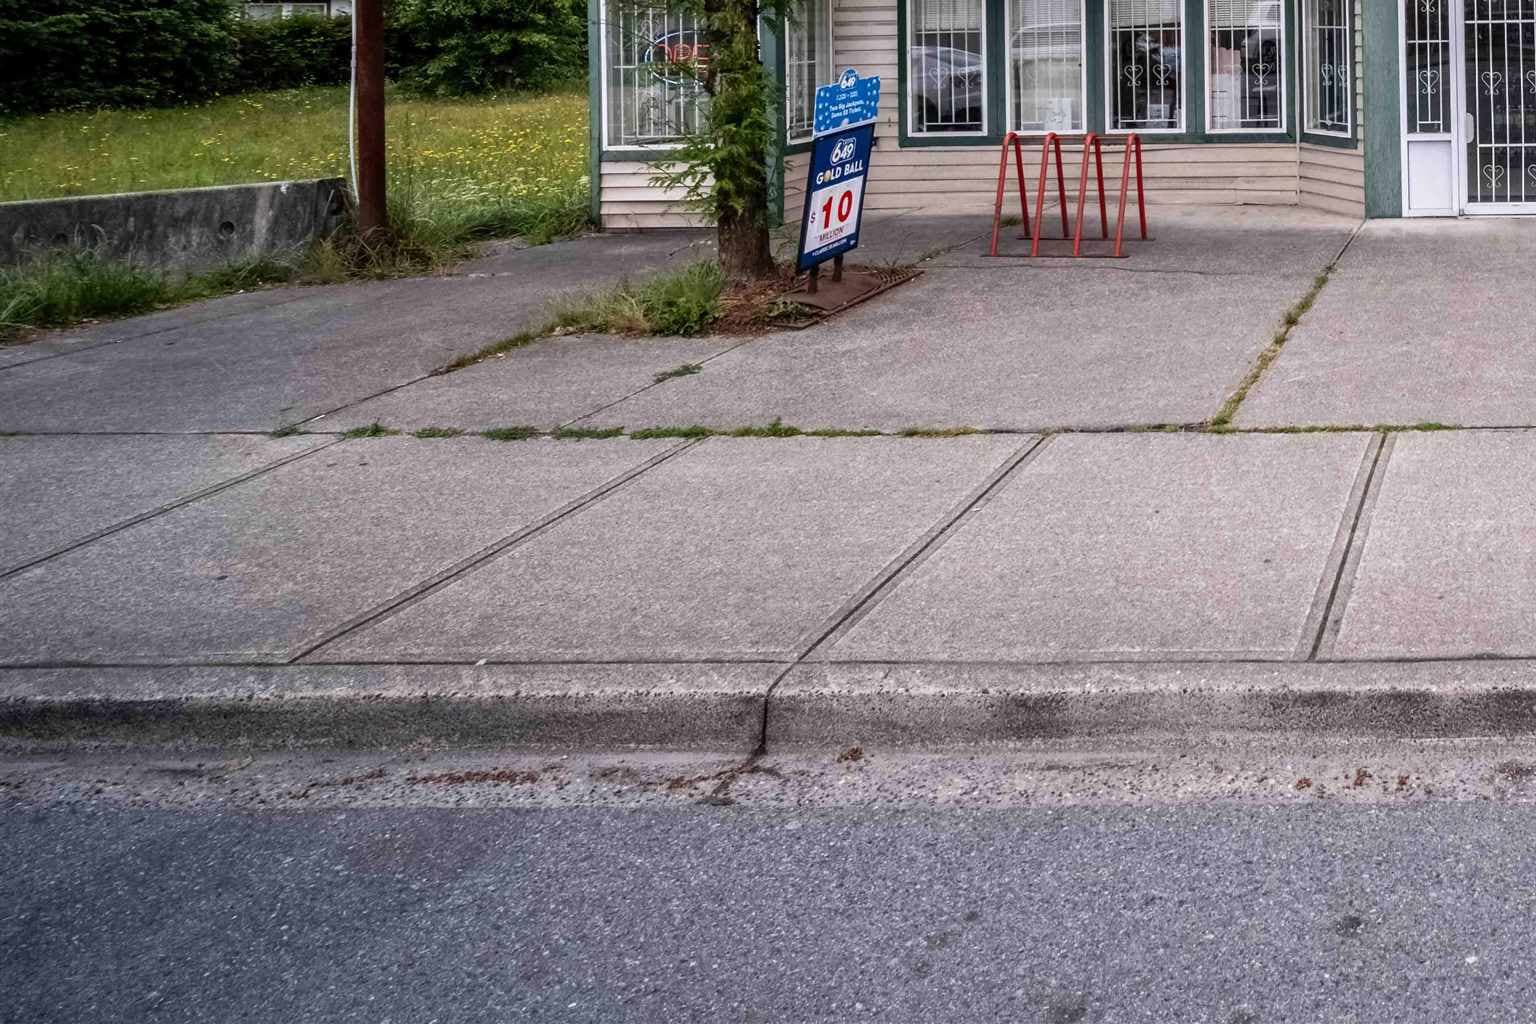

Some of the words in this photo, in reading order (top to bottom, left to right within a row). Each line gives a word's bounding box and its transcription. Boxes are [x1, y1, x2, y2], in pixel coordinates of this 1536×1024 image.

[841, 76, 856, 89] 649
[831, 142, 854, 162] 649
[843, 160, 864, 176] BALL
[822, 190, 853, 230] 10
[818, 226, 844, 241] MILLION
